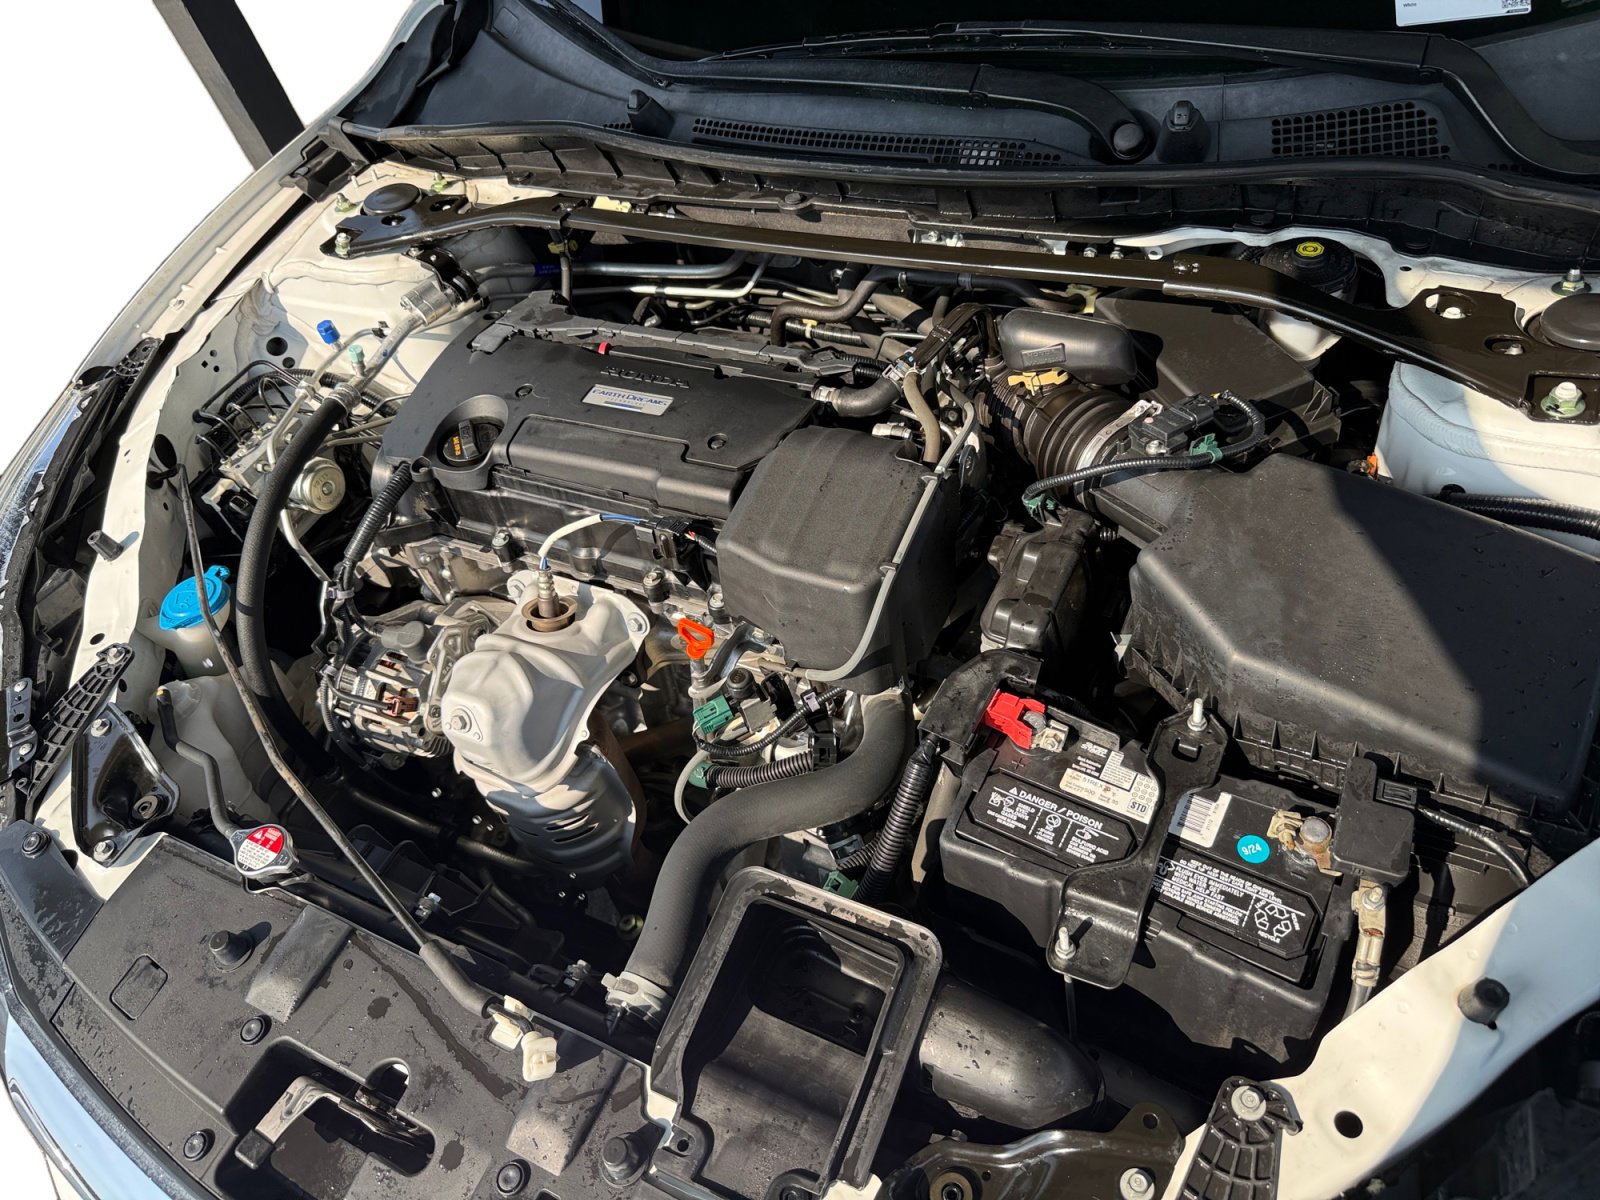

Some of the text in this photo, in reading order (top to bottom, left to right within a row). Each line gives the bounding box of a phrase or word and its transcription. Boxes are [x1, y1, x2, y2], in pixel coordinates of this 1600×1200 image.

[600, 366, 690, 389] HONDA
[592, 389, 625, 399] EARTH
[1018, 789, 1058, 811] DANGER
[1065, 809, 1102, 830] POISON
[1130, 800, 1146, 813] STD
[1241, 843, 1262, 856] 9/24
[1171, 876, 1224, 900] MEDICAL HELP FAST
[1173, 871, 1187, 880] WITH
[1208, 885, 1219, 893] GET
[1175, 865, 1244, 897] FLUSH EYES IMMEDIATELY
[1256, 930, 1280, 944] RECYCLE
